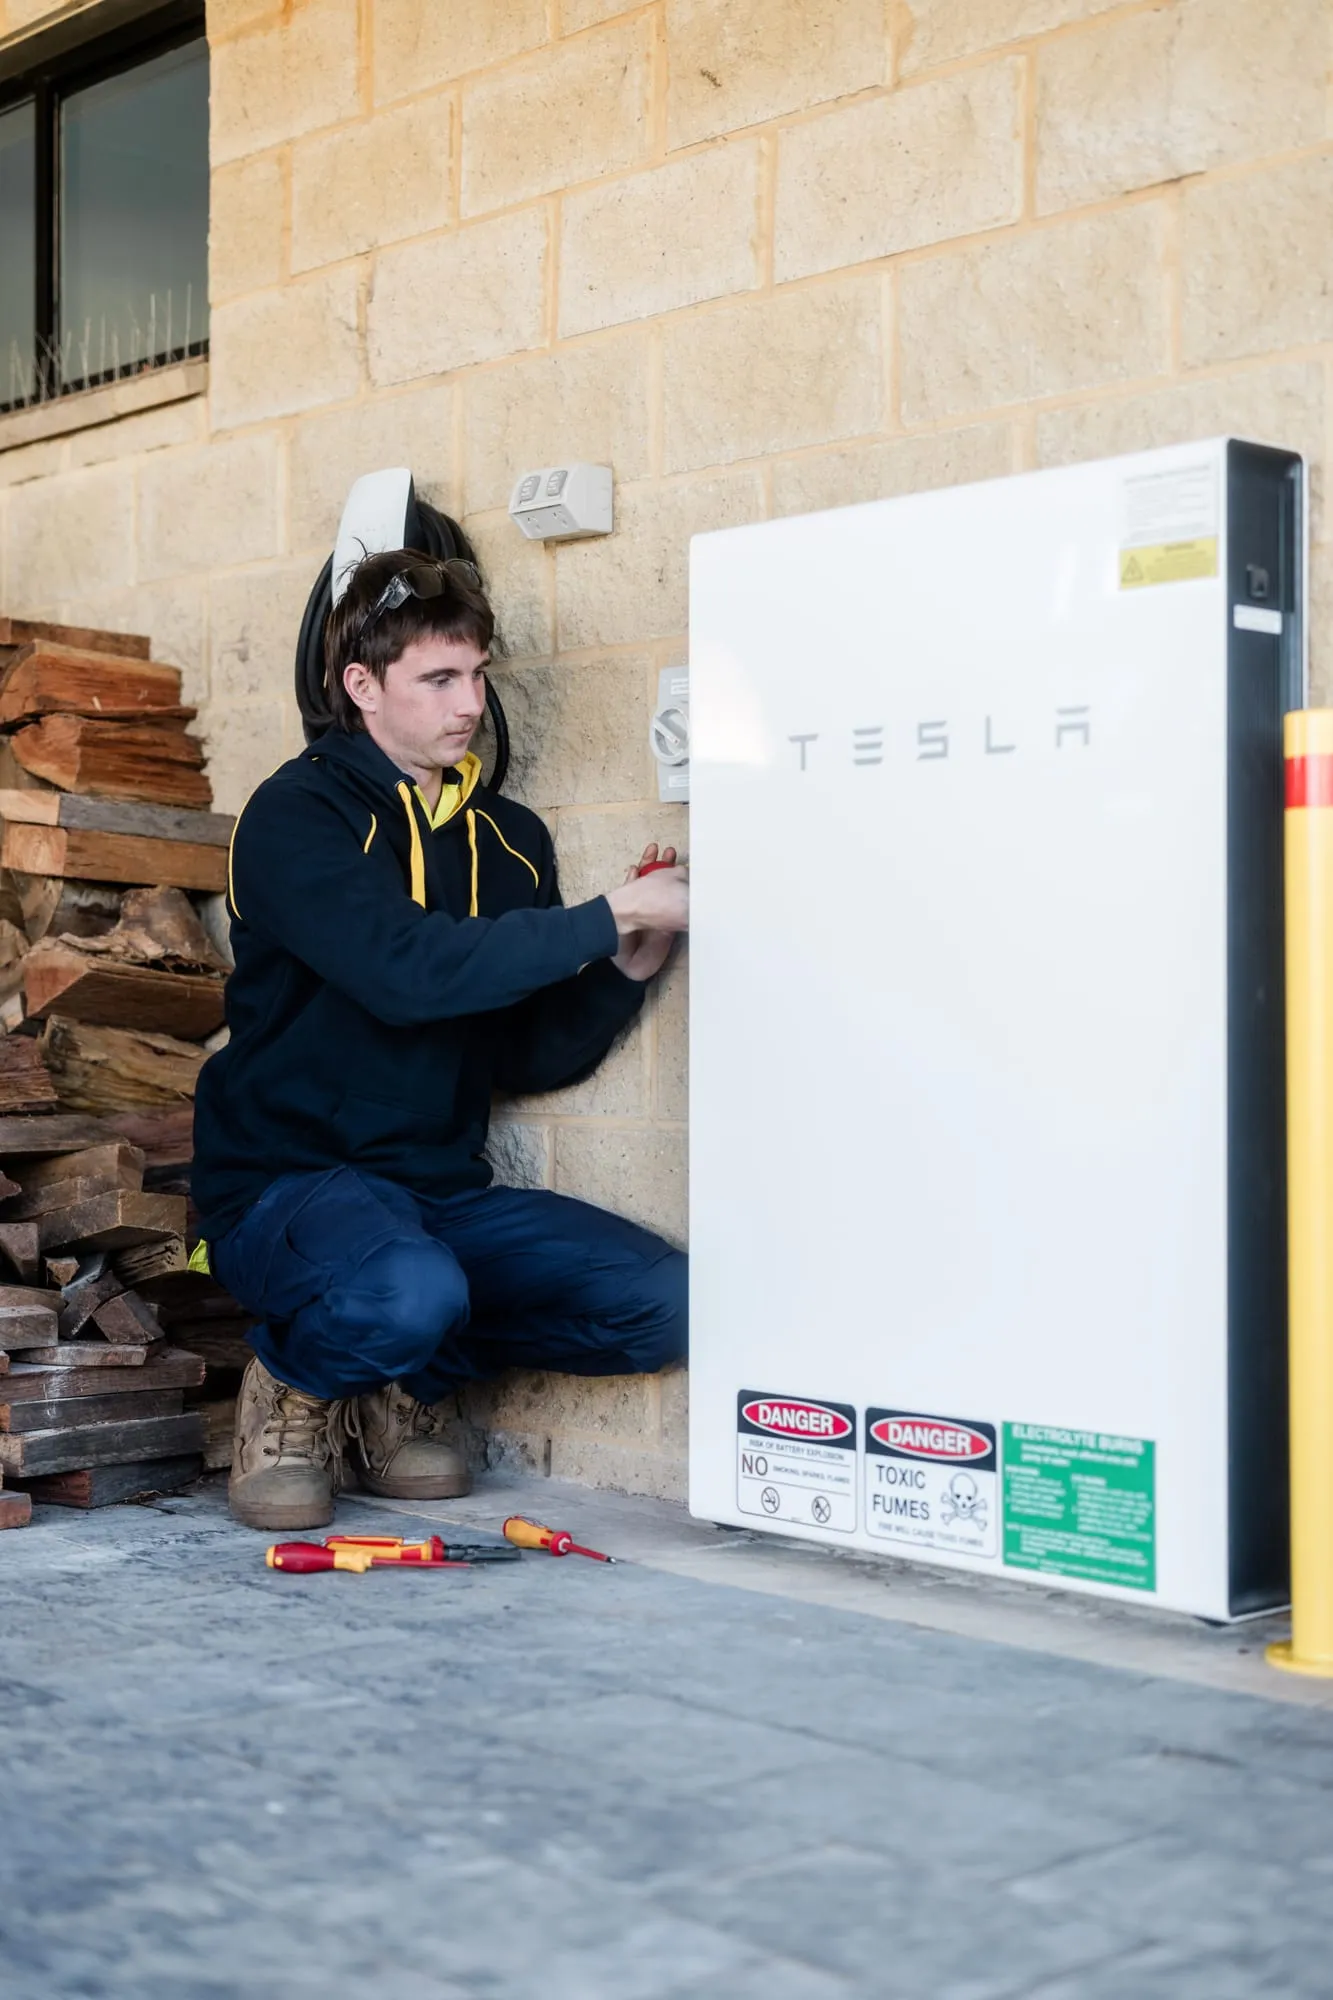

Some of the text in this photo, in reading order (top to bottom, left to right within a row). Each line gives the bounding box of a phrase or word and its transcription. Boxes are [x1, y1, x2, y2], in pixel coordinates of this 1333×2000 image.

[788, 706, 1090, 771] TESLA
[758, 1404, 834, 1435] DANGER
[749, 1439, 845, 1460] RISK OF BATTERY EXPLOSION
[888, 1422, 972, 1455] DANGER
[1011, 1424, 1097, 1449] ELECTROLYTE
[1099, 1437, 1144, 1456] BURNS
[742, 1453, 768, 1476] NO
[876, 1464, 926, 1489] TOXIC
[873, 1494, 930, 1521] FUMES
